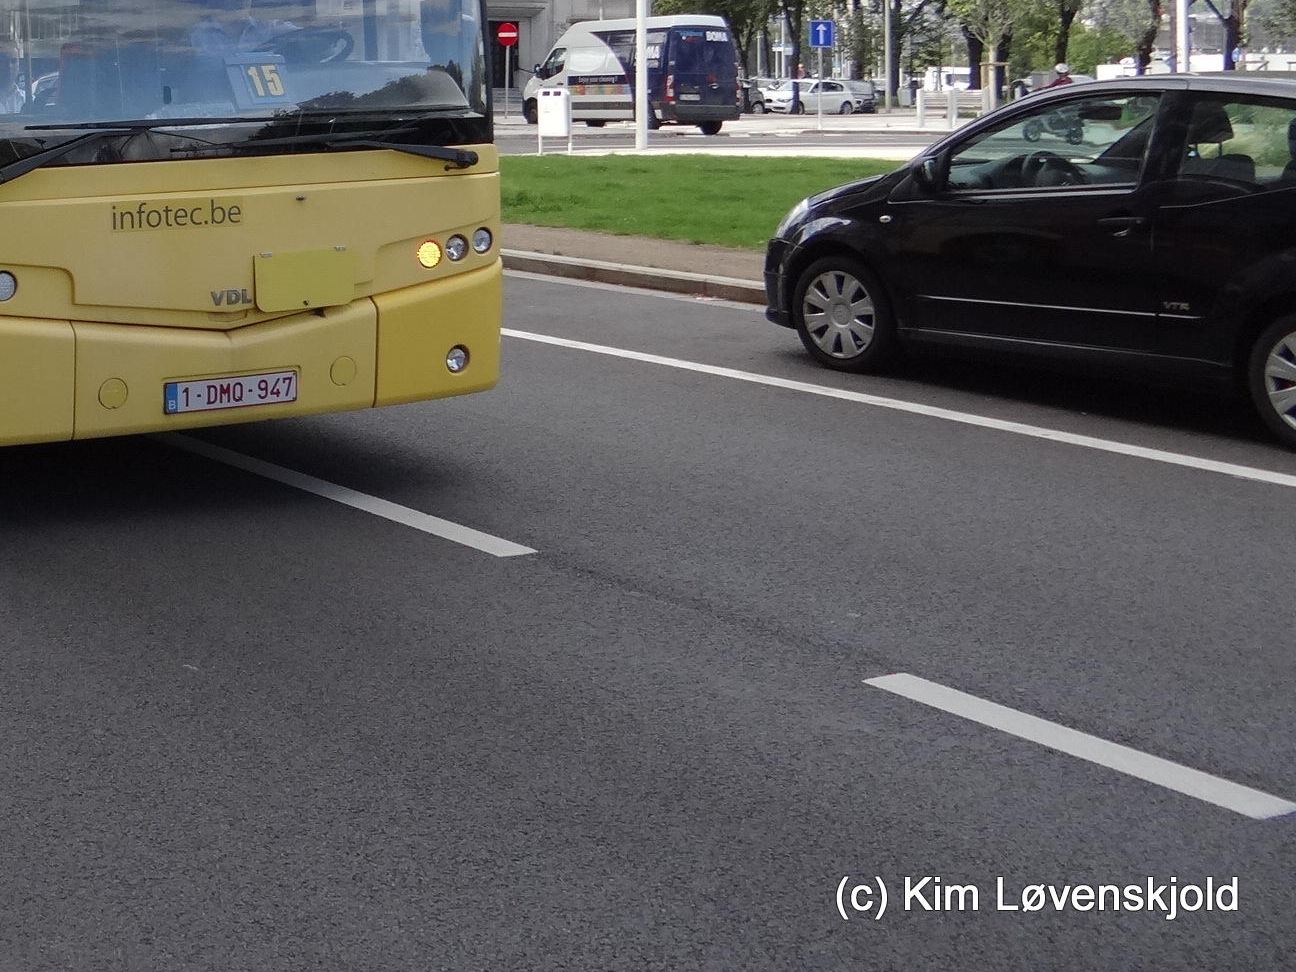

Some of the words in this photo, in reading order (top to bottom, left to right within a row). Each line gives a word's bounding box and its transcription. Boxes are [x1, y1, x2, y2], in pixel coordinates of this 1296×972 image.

[247, 64, 285, 97] 15
[111, 198, 242, 230] infotec.be
[210, 288, 253, 307] VDL
[168, 399, 177, 411] B
[181, 376, 294, 408] 1-DMQ-947
